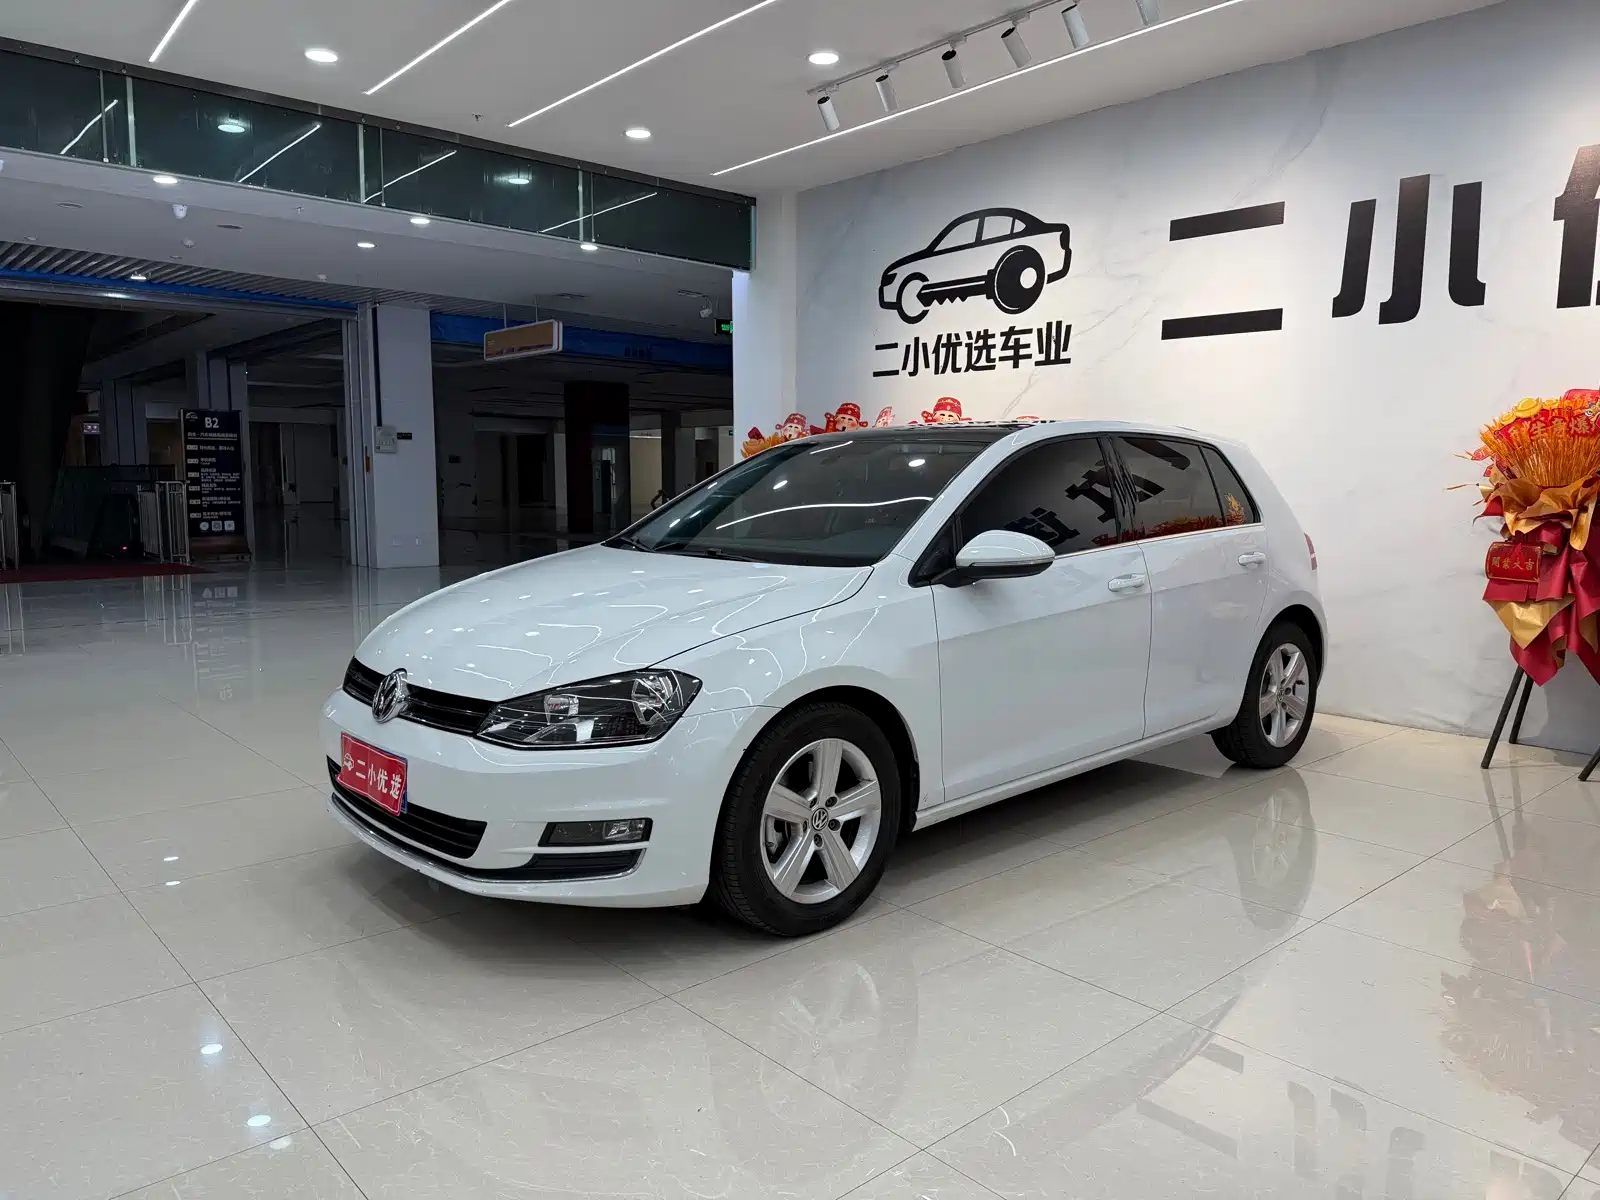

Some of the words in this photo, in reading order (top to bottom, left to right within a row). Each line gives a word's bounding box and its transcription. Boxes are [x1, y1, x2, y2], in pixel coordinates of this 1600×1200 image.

[872, 320, 1072, 377] 二小优选车业
[204, 416, 220, 429] B2
[355, 759, 402, 799] 二小优选
